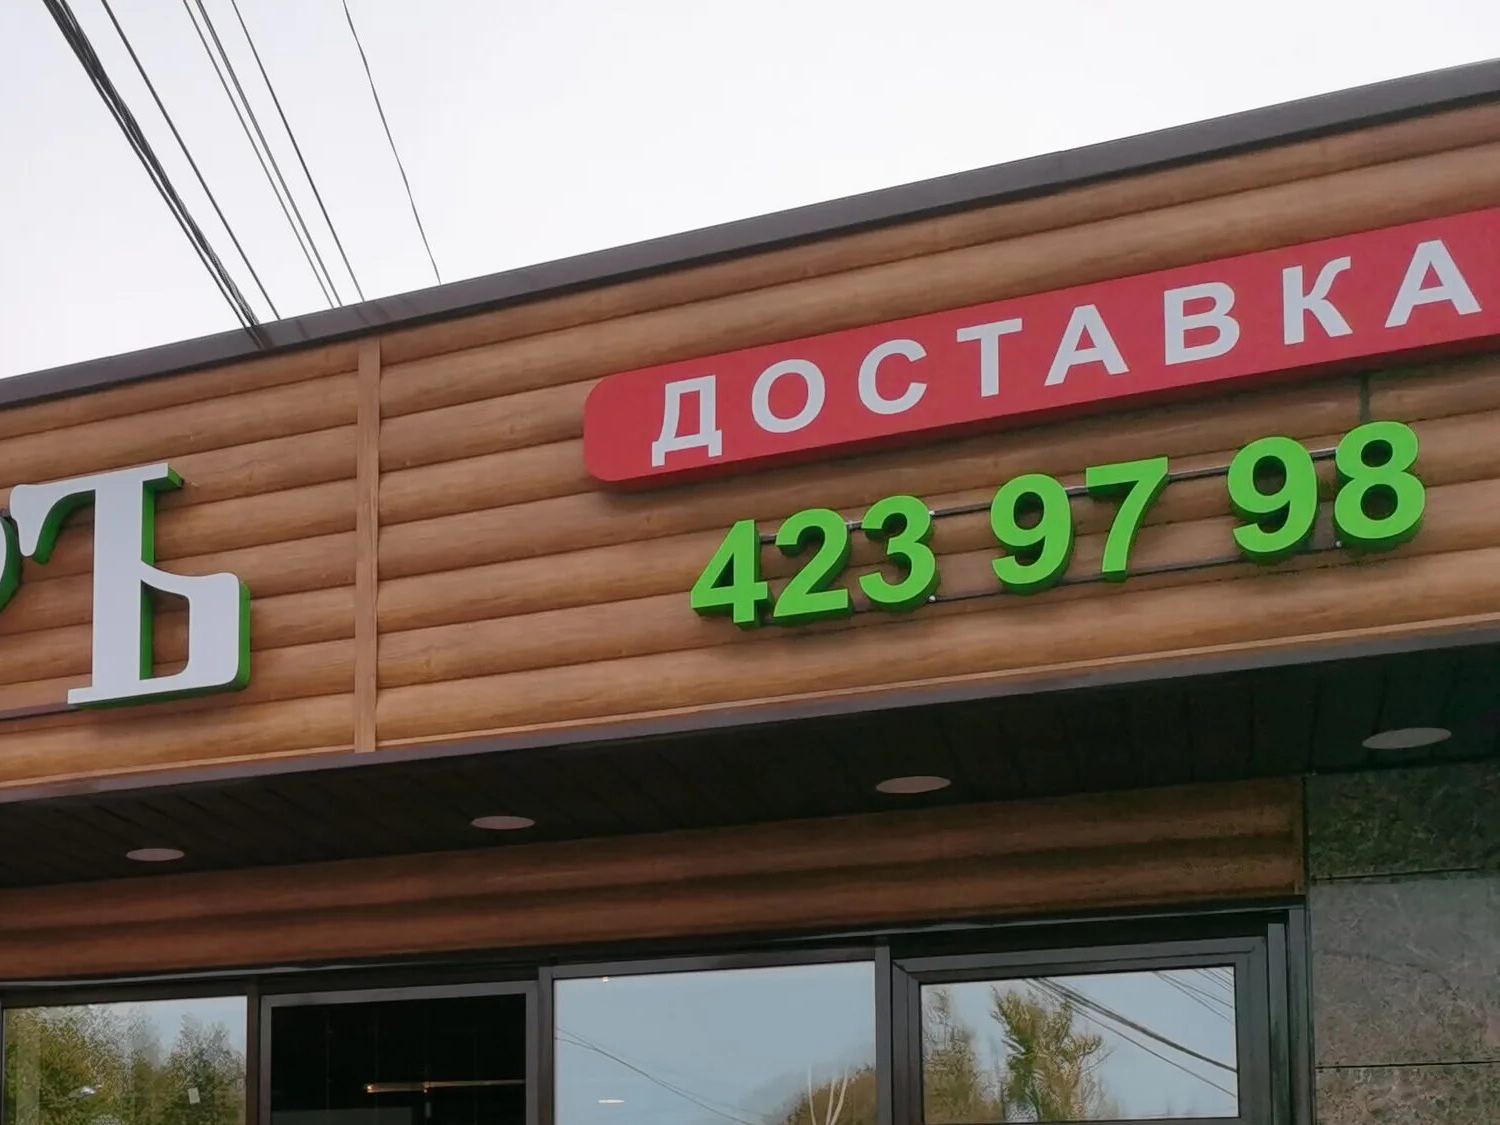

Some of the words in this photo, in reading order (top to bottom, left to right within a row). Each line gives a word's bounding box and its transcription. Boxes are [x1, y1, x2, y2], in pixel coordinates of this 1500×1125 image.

[651, 238, 1483, 467] ДОСТАВКА
[690, 494, 941, 629] 423
[990, 454, 1171, 595] 97
[1226, 420, 1427, 565] 98
